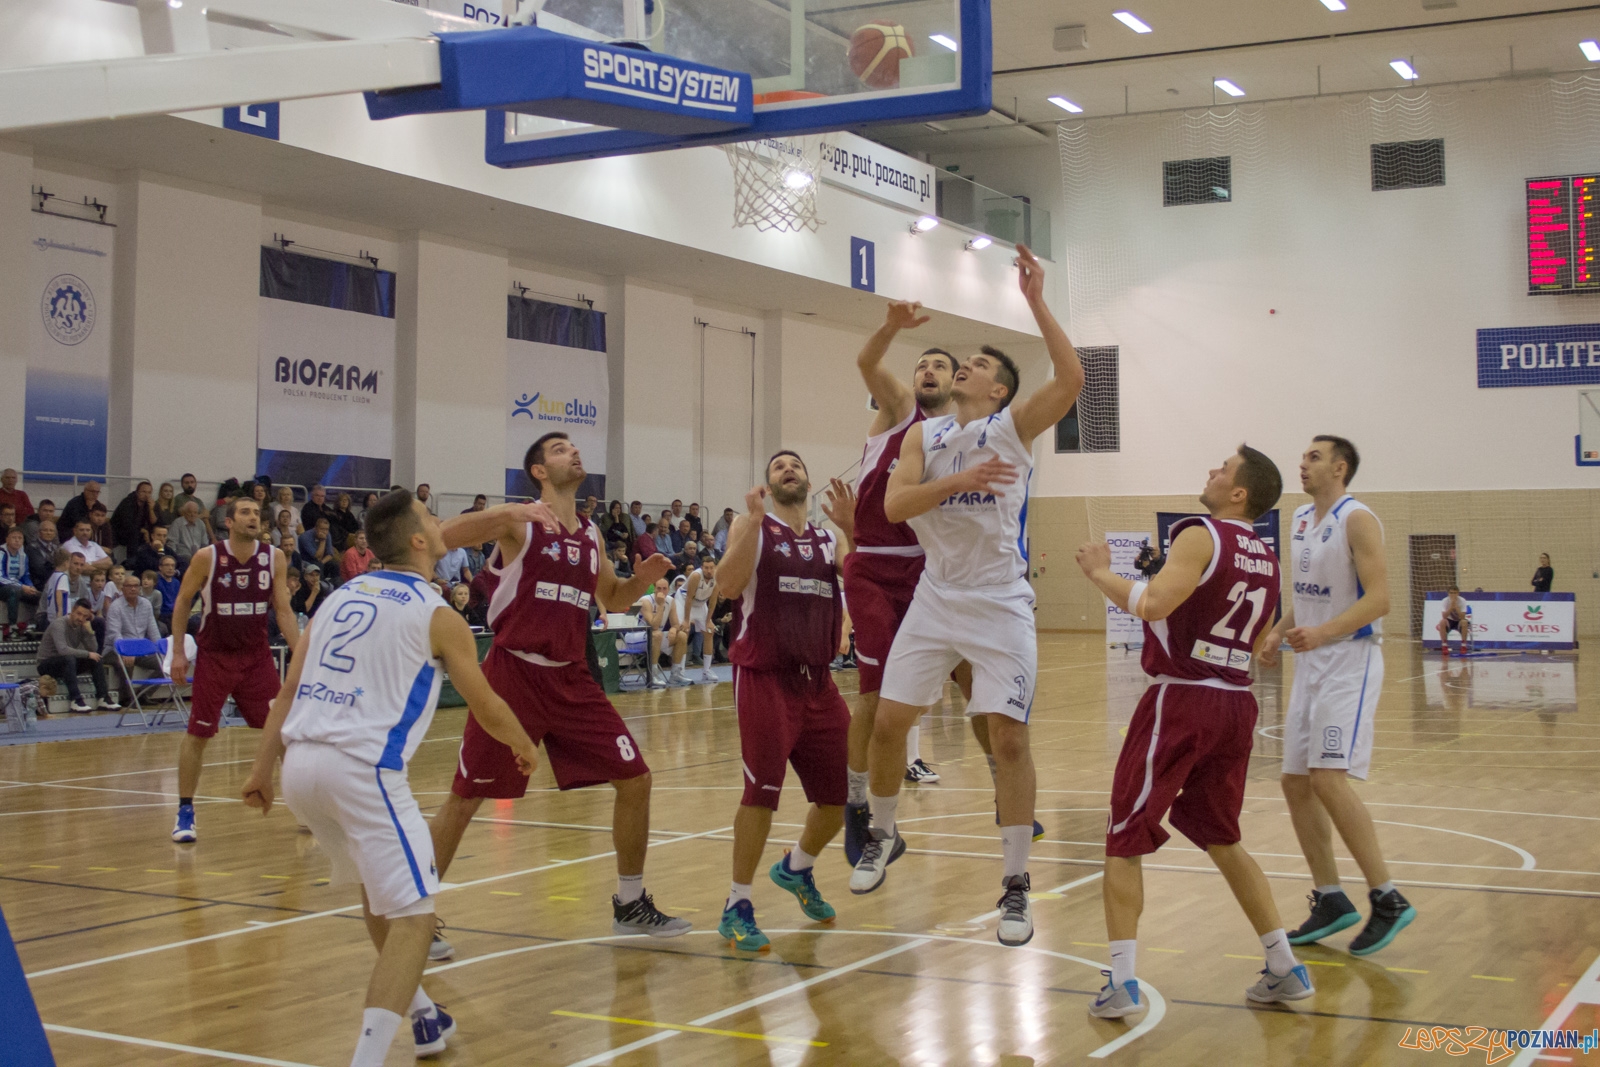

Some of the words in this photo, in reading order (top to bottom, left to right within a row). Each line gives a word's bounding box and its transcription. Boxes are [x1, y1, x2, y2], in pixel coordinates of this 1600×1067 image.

[858, 245, 868, 286] 1
[1500, 341, 1600, 370] POLITE
[274, 356, 378, 394] BIOFARM
[283, 388, 308, 398] POLSKI
[309, 391, 349, 402] PRODUCENT
[538, 394, 597, 418] funclub
[538, 413, 562, 422] biuro
[258, 570, 270, 590] 9
[536, 587, 554, 598] PEC
[780, 581, 796, 590] PEC
[1210, 581, 1267, 644] 21
[319, 600, 377, 673] 2
[1505, 624, 1560, 633] CYMES
[1014, 675, 1026, 701] 1
[616, 735, 636, 761] 8
[1323, 725, 1342, 751] 8
